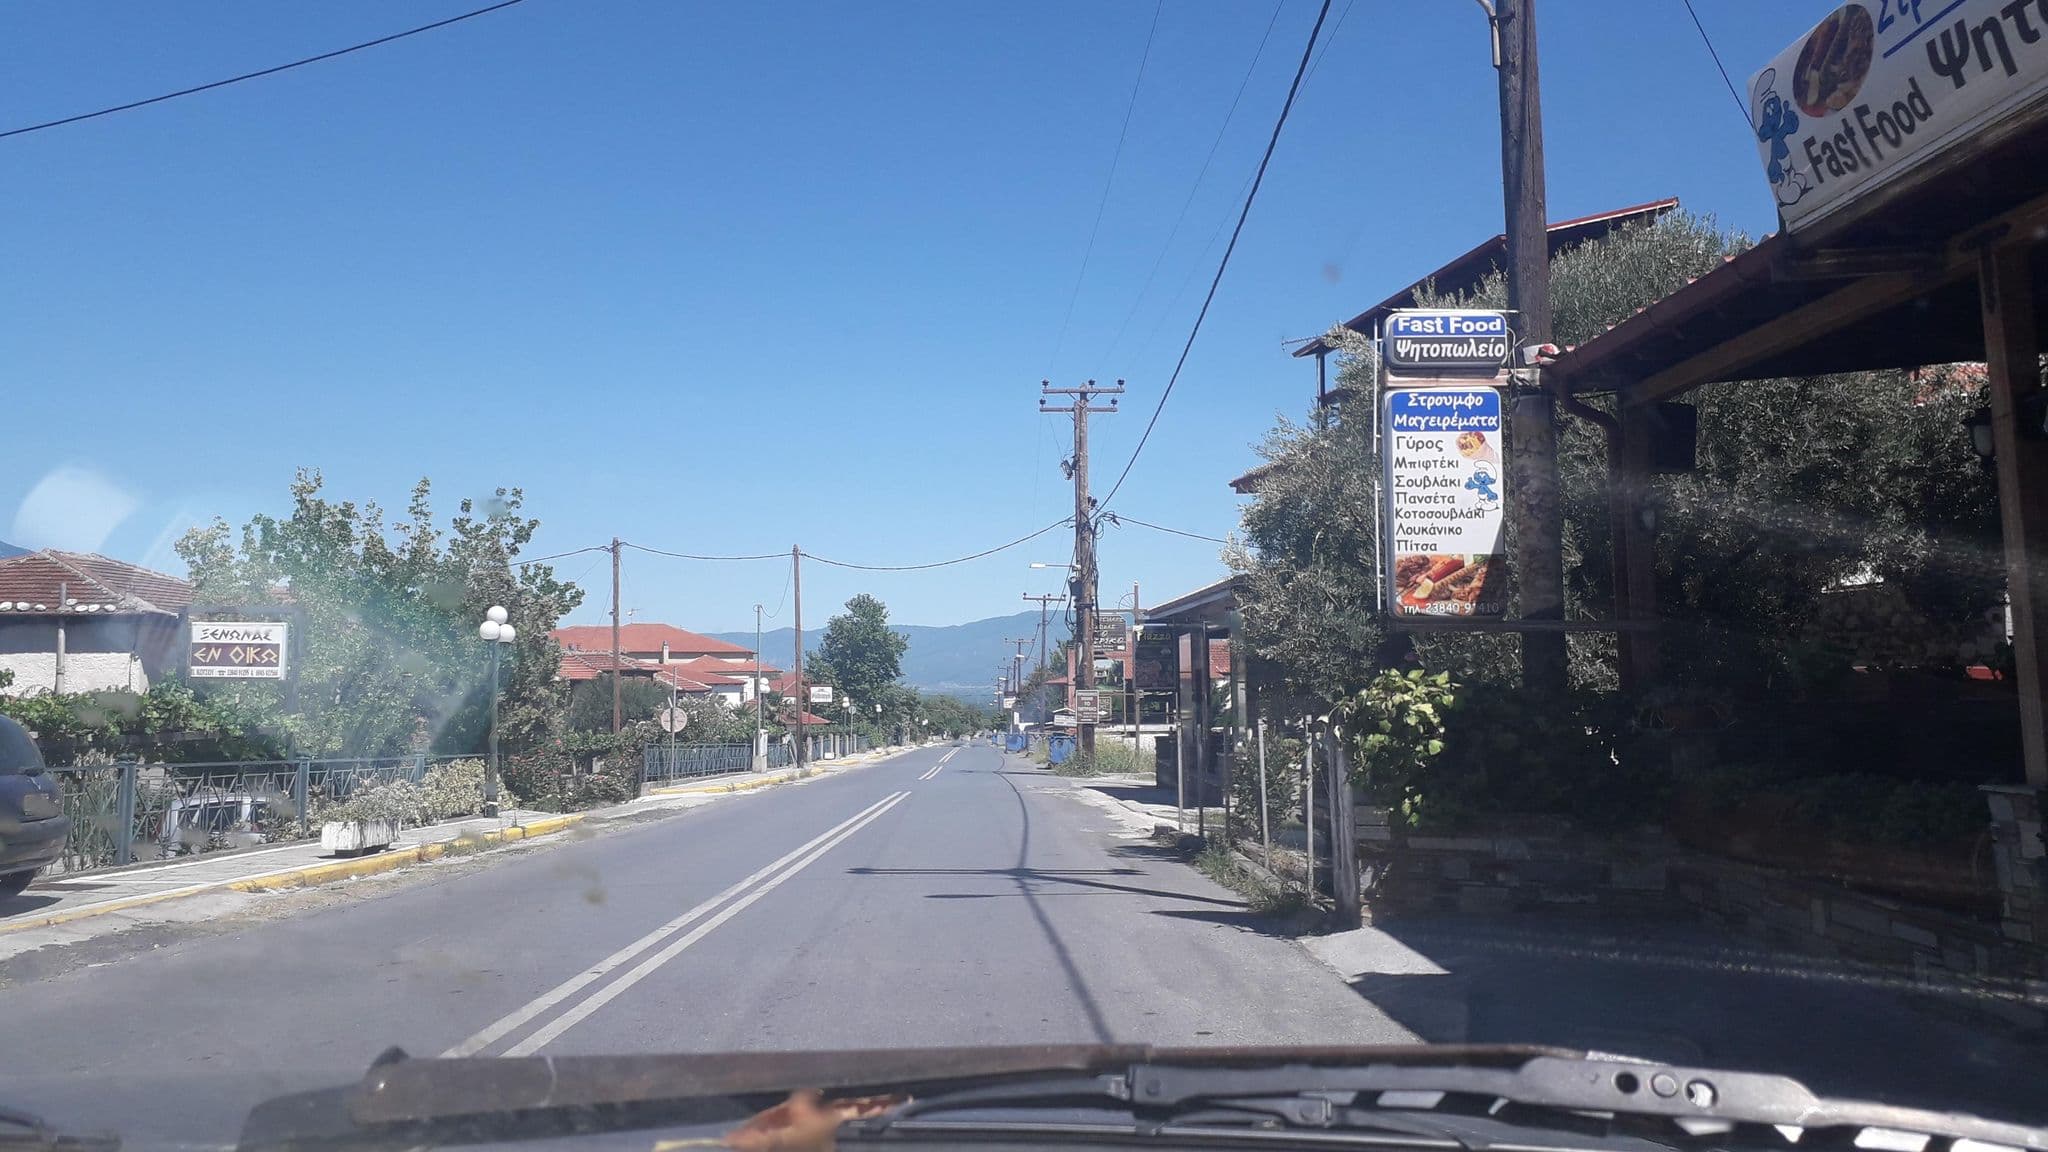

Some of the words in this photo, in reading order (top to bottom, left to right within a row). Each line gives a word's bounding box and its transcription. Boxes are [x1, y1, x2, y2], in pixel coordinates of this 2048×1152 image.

[1804, 117, 1874, 184] Fast
[1853, 76, 1934, 160] Food
[1397, 317, 1443, 333] Fast
[1449, 317, 1502, 333] Food
[1396, 338, 1505, 362] Ψητοπωλείο
[1407, 393, 1484, 410] Στρουμφο
[1394, 411, 1498, 430] Μαγειρέματα
[1396, 435, 1444, 453] Γύρος
[1394, 455, 1460, 471] Μπιφτέκι
[1394, 474, 1461, 490] Σουβλάκι
[1395, 491, 1456, 505] Πανσέτα
[1395, 506, 1485, 522] Κοτοσουβλάκι
[1395, 522, 1463, 537] Λουκάνικο
[1396, 539, 1438, 553] Πίτσα
[1425, 602, 1460, 613] 23840
[193, 647, 222, 663] ΕΝ
[229, 645, 278, 664] ΟΙΚΩ
